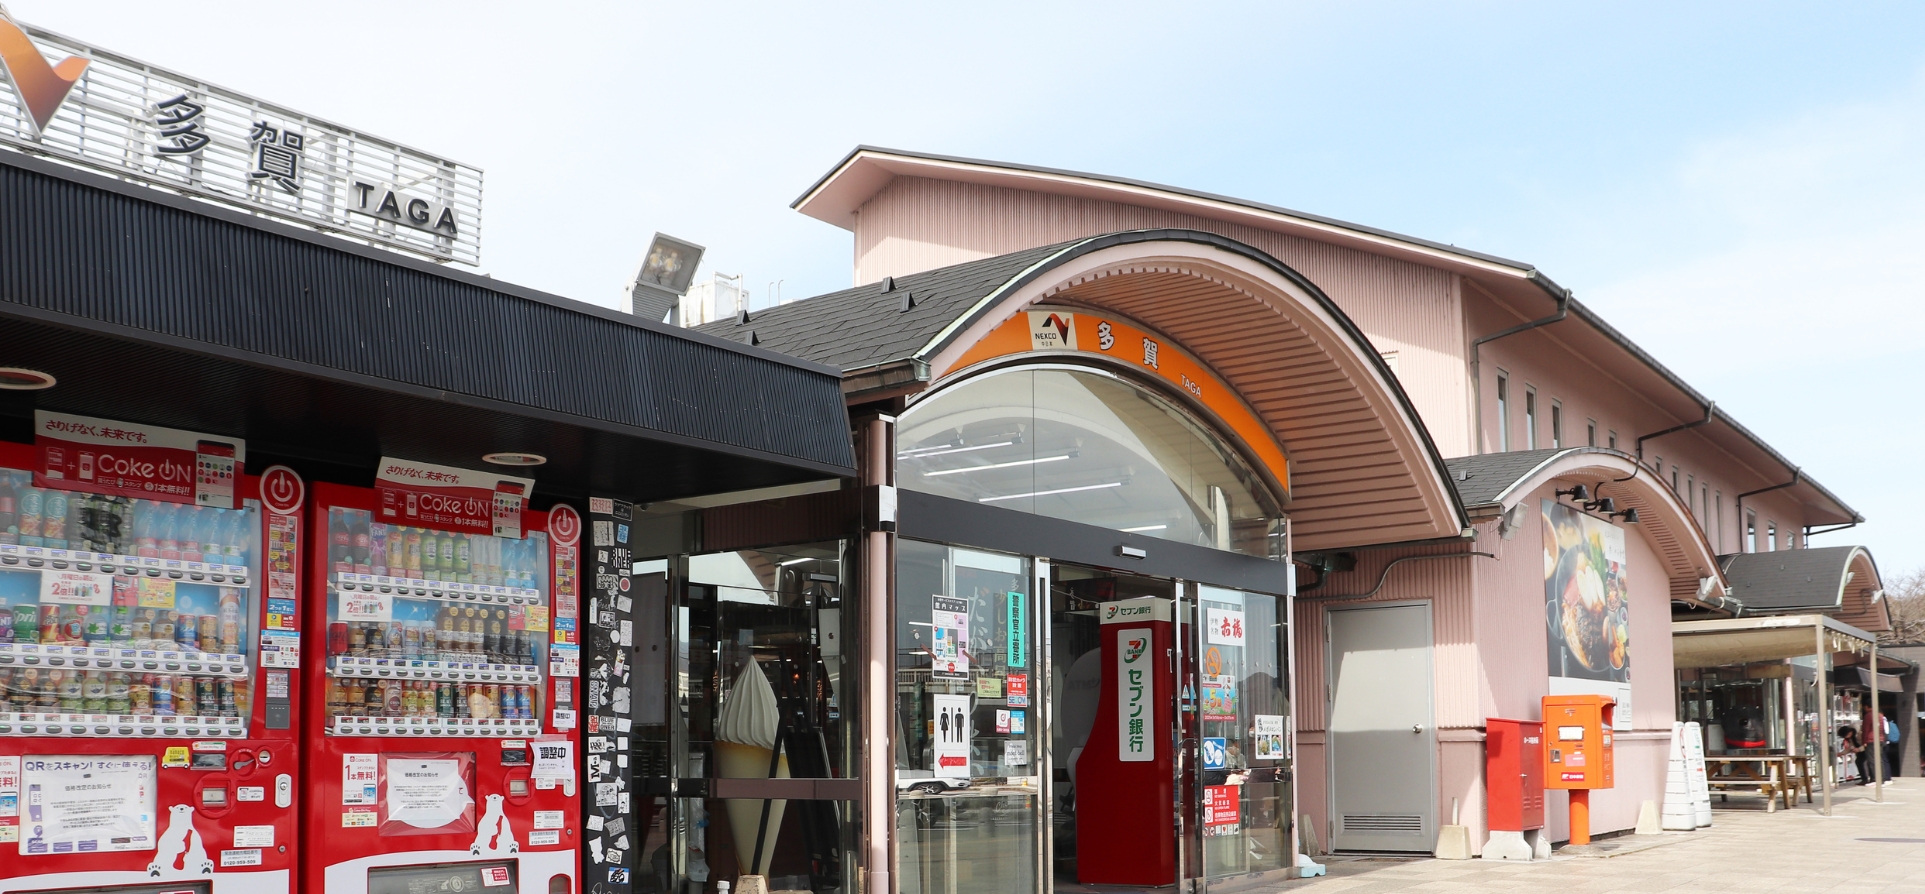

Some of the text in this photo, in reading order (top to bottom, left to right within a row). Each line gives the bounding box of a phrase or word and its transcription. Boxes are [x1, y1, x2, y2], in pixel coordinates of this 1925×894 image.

[152, 93, 458, 234] 多賀 TAGA
[1098, 321, 1202, 397] 多賀 TAGA
[46, 420, 147, 444] さりげなく、未来です。
[98, 454, 154, 478] Coke
[386, 465, 460, 485] さりげなく、未来です。
[420, 494, 462, 514] Coke
[1120, 606, 1151, 616] セブン銀行
[1128, 669, 1144, 752] セブン銀行
[539, 746, 566, 759] 調整中
